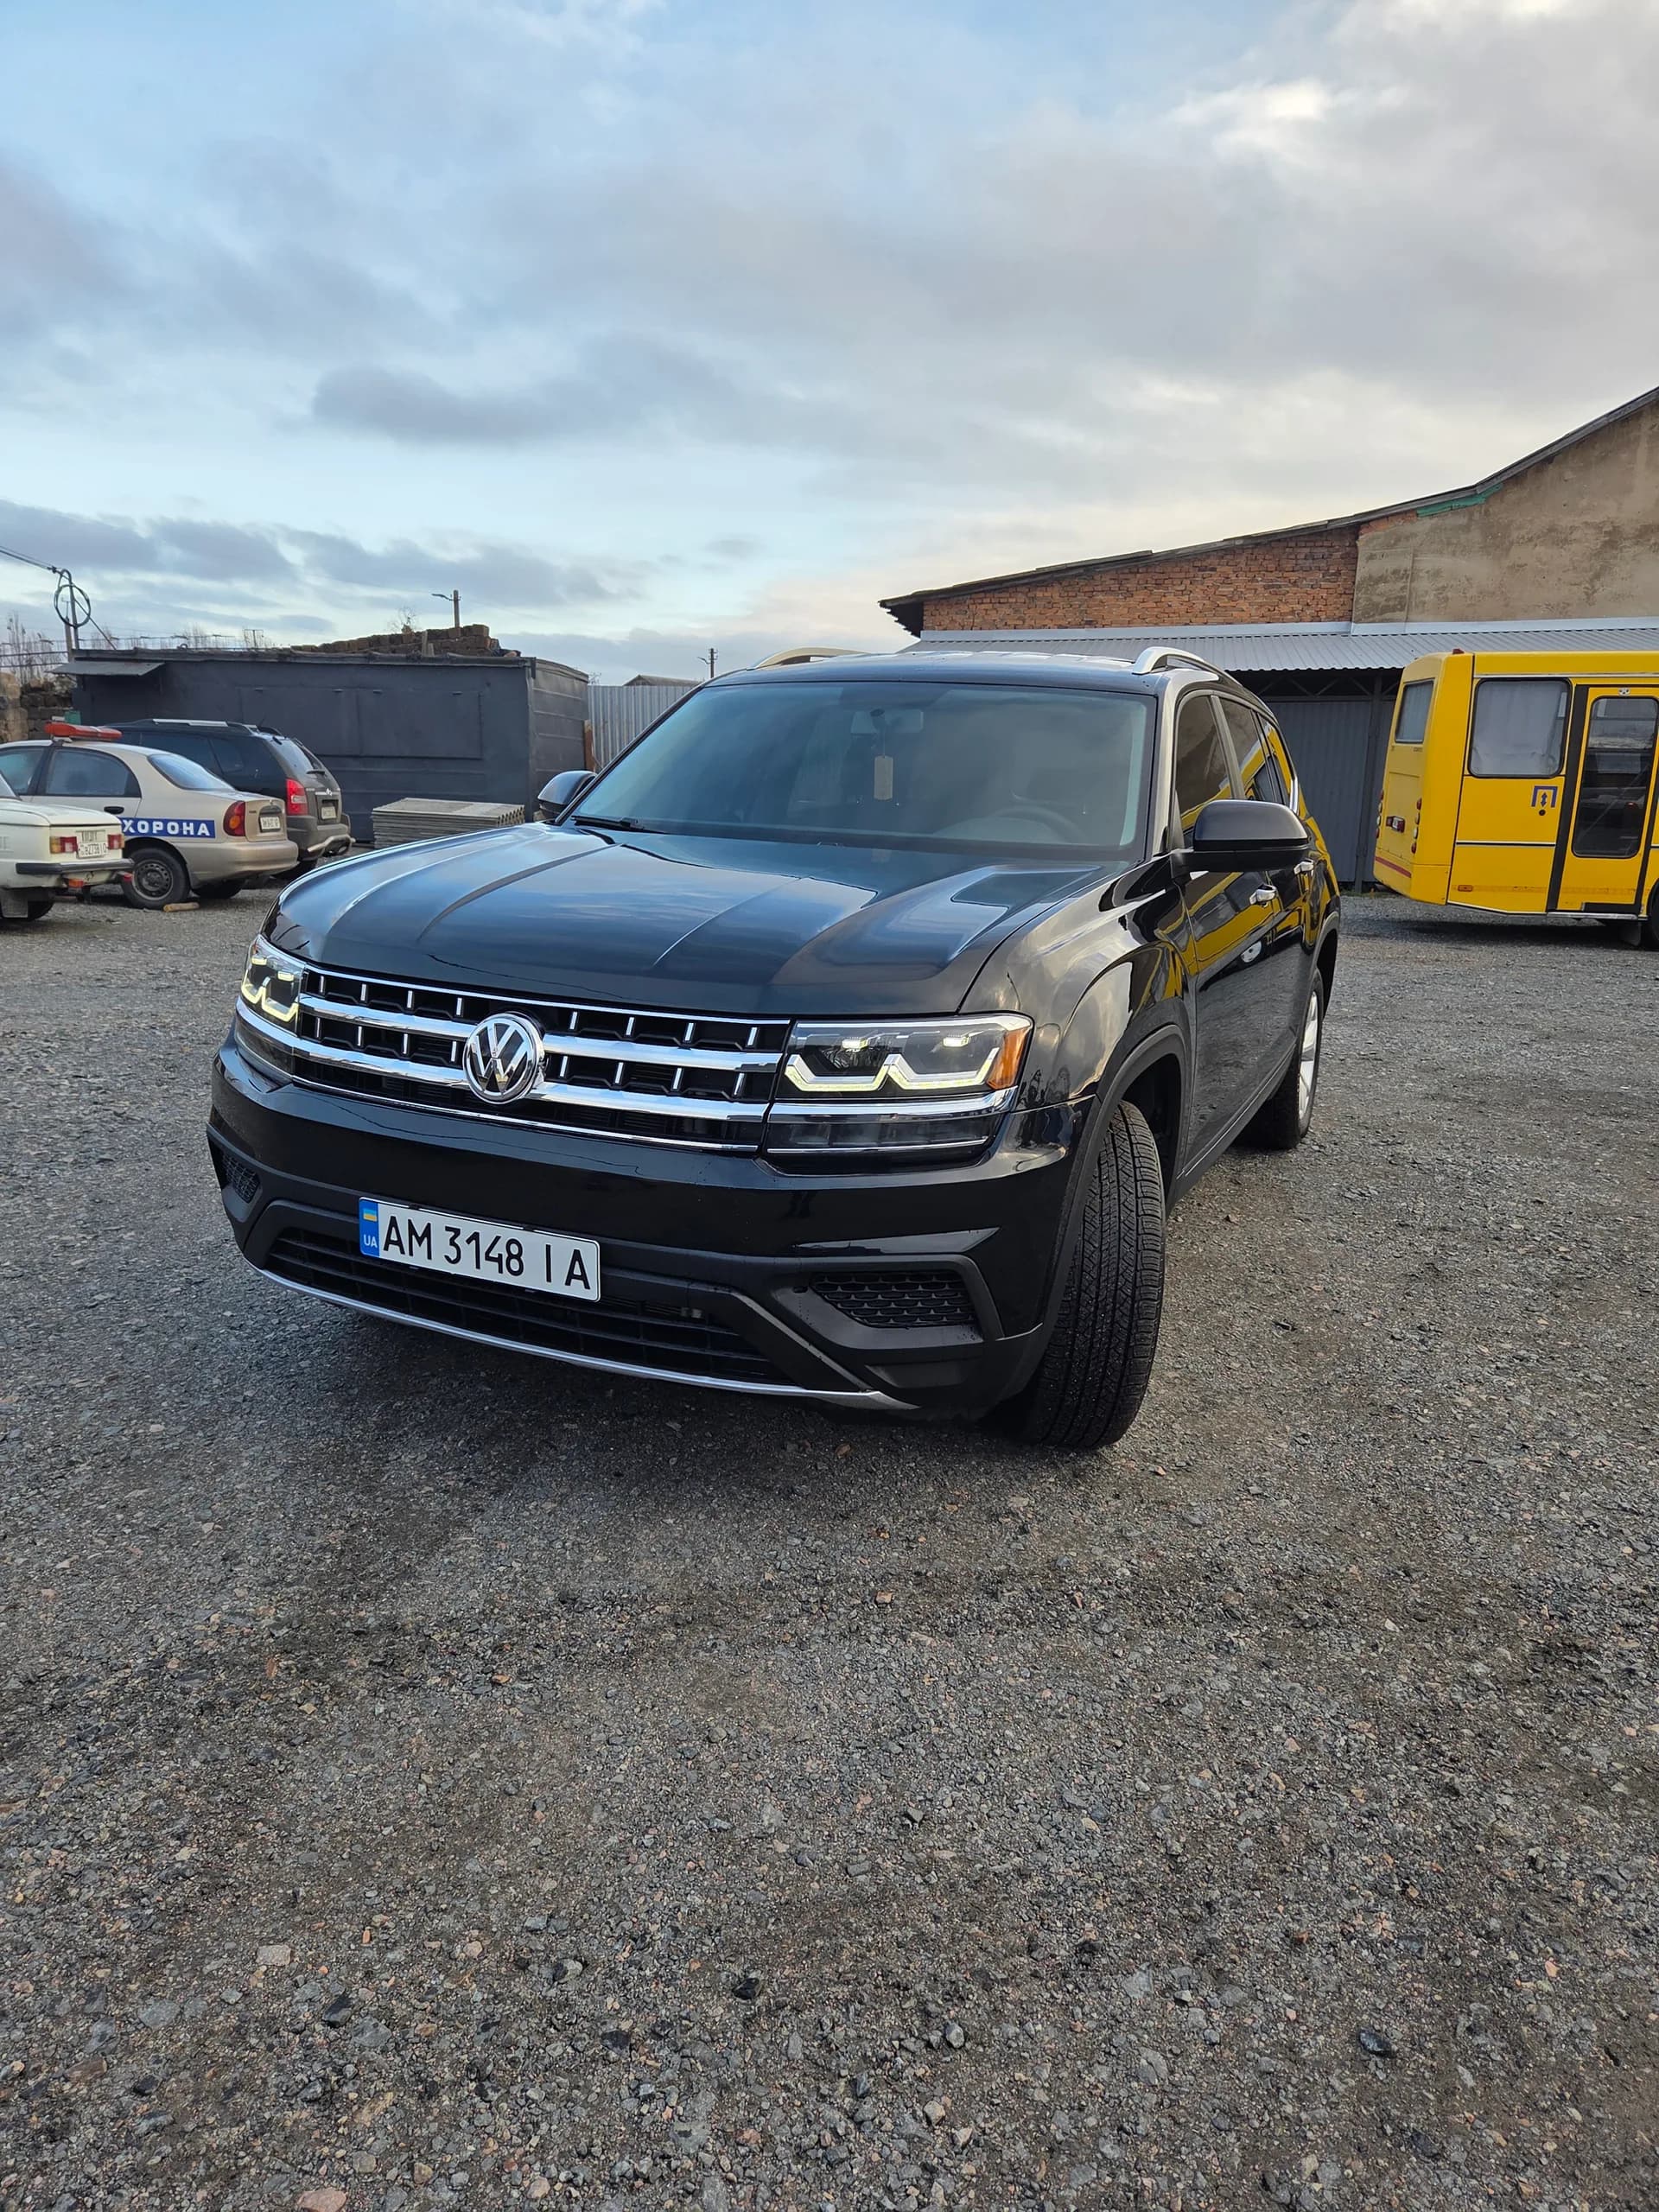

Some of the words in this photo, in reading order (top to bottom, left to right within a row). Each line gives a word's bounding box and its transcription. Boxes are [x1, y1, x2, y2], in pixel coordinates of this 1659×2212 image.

[363, 1234, 378, 1249] UA
[383, 1215, 432, 1261] AM
[443, 1225, 524, 1276] 3148
[544, 1243, 591, 1290] IA
